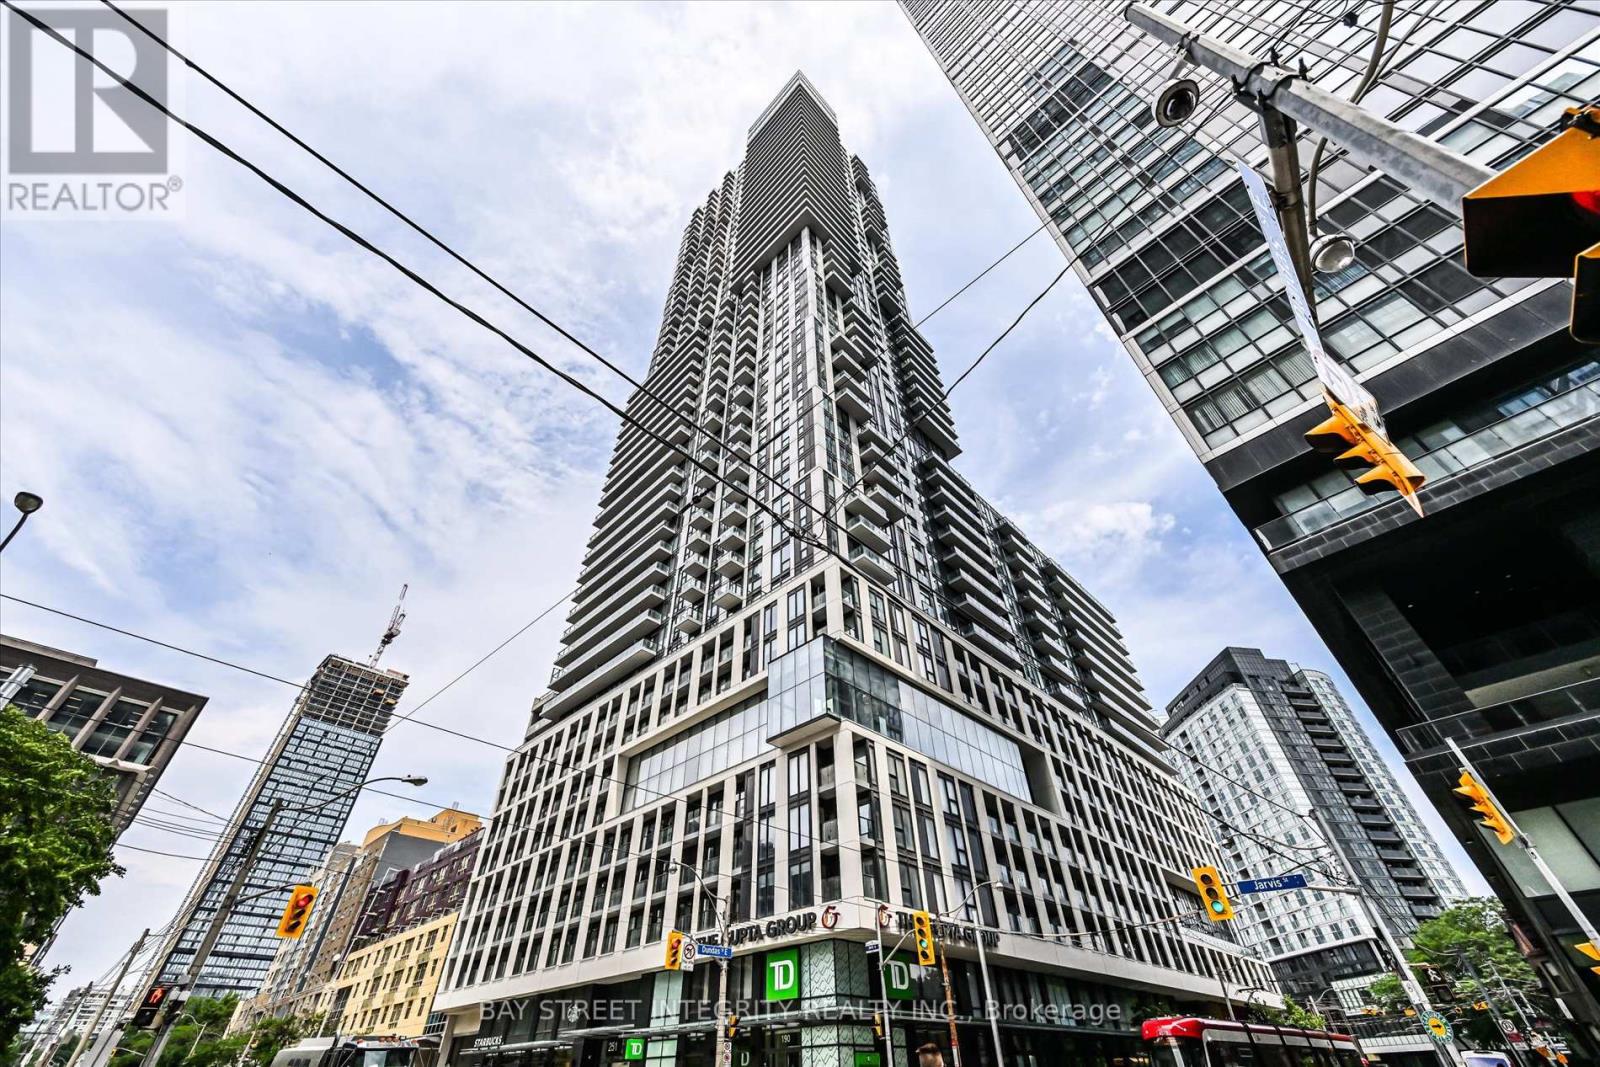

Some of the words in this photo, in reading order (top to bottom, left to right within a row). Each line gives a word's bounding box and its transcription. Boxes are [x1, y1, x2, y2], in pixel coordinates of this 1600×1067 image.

[1254, 879, 1283, 890] Jarvis
[765, 911, 817, 938] GROUP
[701, 945, 721, 955] Dundas
[769, 959, 795, 991] TD
[886, 960, 909, 990] TD
[781, 1034, 791, 1043] 190
[631, 1043, 642, 1056] TD
